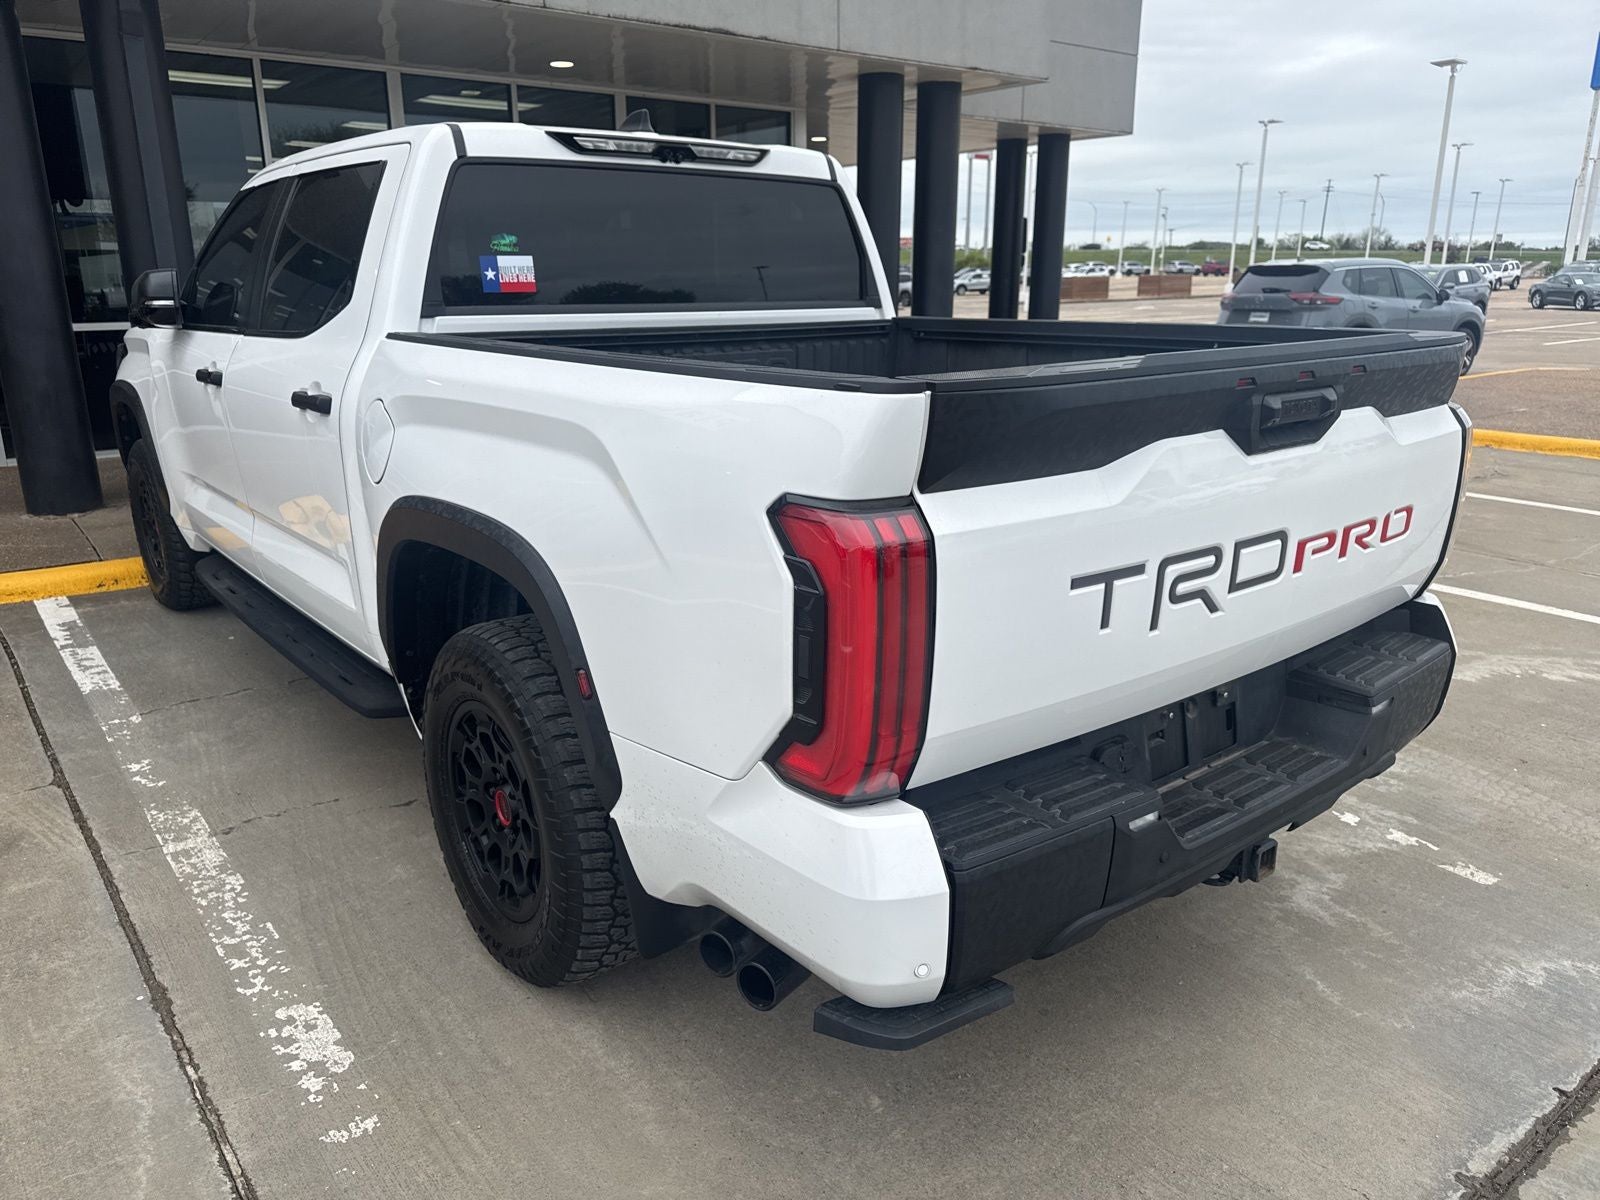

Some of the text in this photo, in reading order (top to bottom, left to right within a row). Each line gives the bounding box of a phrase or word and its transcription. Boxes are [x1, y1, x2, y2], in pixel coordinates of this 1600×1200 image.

[518, 266, 535, 274] HERE
[499, 274, 536, 283] LIVES HERE
[1069, 504, 1415, 634] TRD PRO
